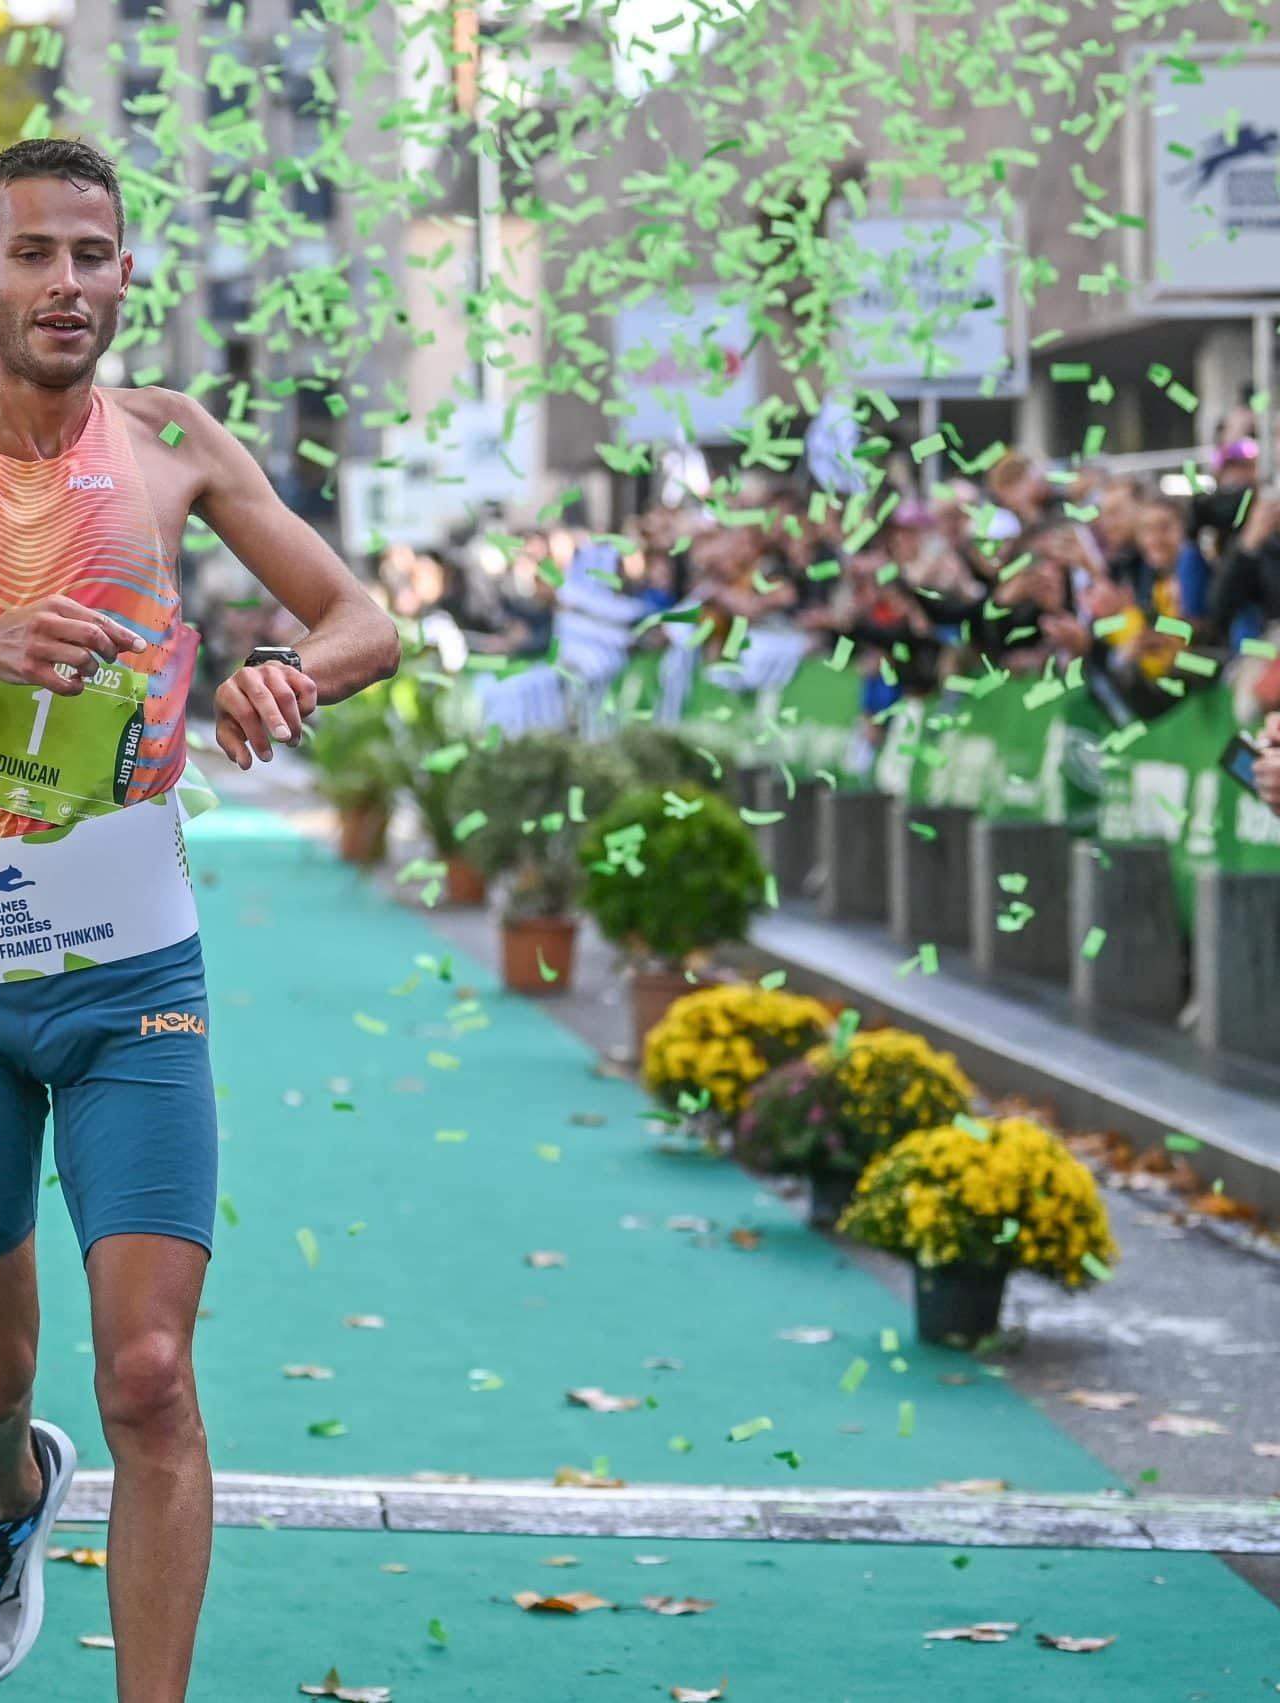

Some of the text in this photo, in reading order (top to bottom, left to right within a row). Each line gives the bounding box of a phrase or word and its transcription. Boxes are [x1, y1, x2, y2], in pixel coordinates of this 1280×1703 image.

[69, 475, 114, 489] HOKA
[84, 667, 122, 689] 025
[27, 688, 54, 756] 1
[124, 722, 142, 756] SUPER
[54, 922, 114, 949] THINKING
[141, 1012, 206, 1036] HOKA
